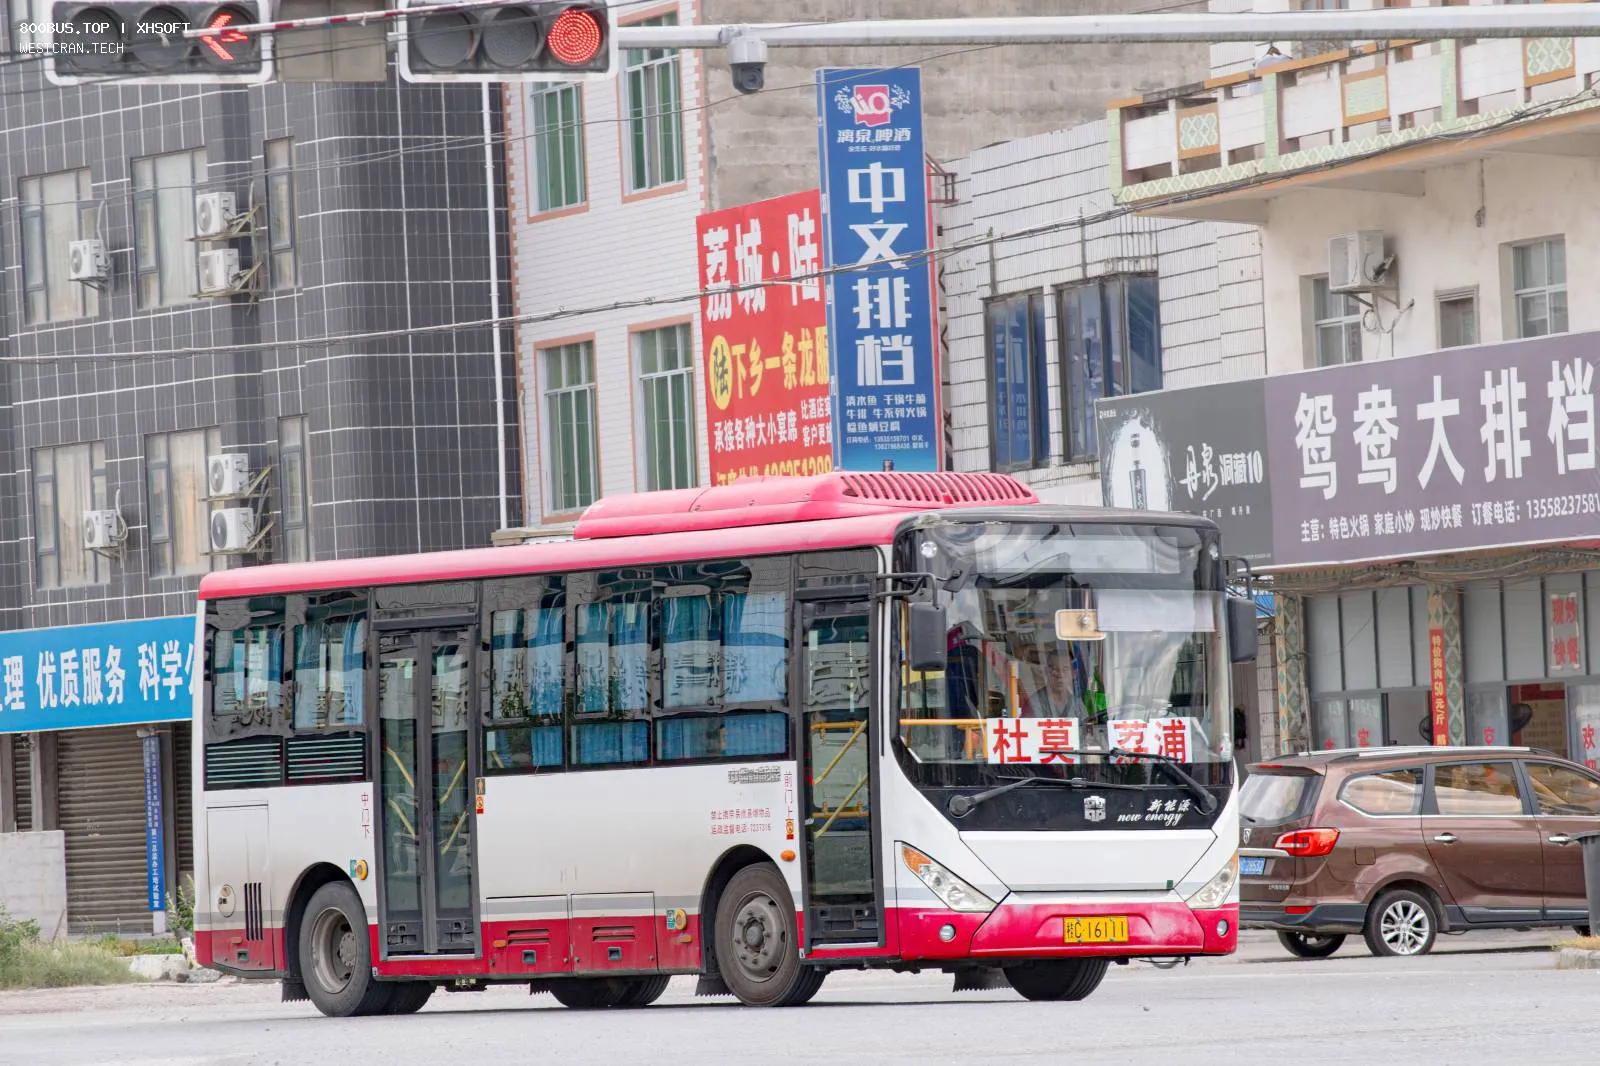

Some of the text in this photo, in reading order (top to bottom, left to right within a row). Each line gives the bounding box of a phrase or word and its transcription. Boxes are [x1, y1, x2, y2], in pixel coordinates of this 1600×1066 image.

[847, 161, 915, 387] 中文排档
[714, 408, 798, 453] 承接各种大小宴席
[1294, 357, 1596, 500] 鸳鸯大排档
[1329, 513, 1370, 540] 特色火锅
[1374, 509, 1415, 536] 家庭小炒
[1420, 503, 1463, 531] 现炒快餐
[1526, 492, 1600, 519] 13558237581
[0, 655, 25, 712] 理
[36, 643, 125, 709] 优质服务
[992, 718, 1187, 764] 杜莫 荔浦
[361, 792, 370, 838] 中门下
[1117, 813, 1184, 827] new energy
[1147, 799, 1192, 812] 新能源
